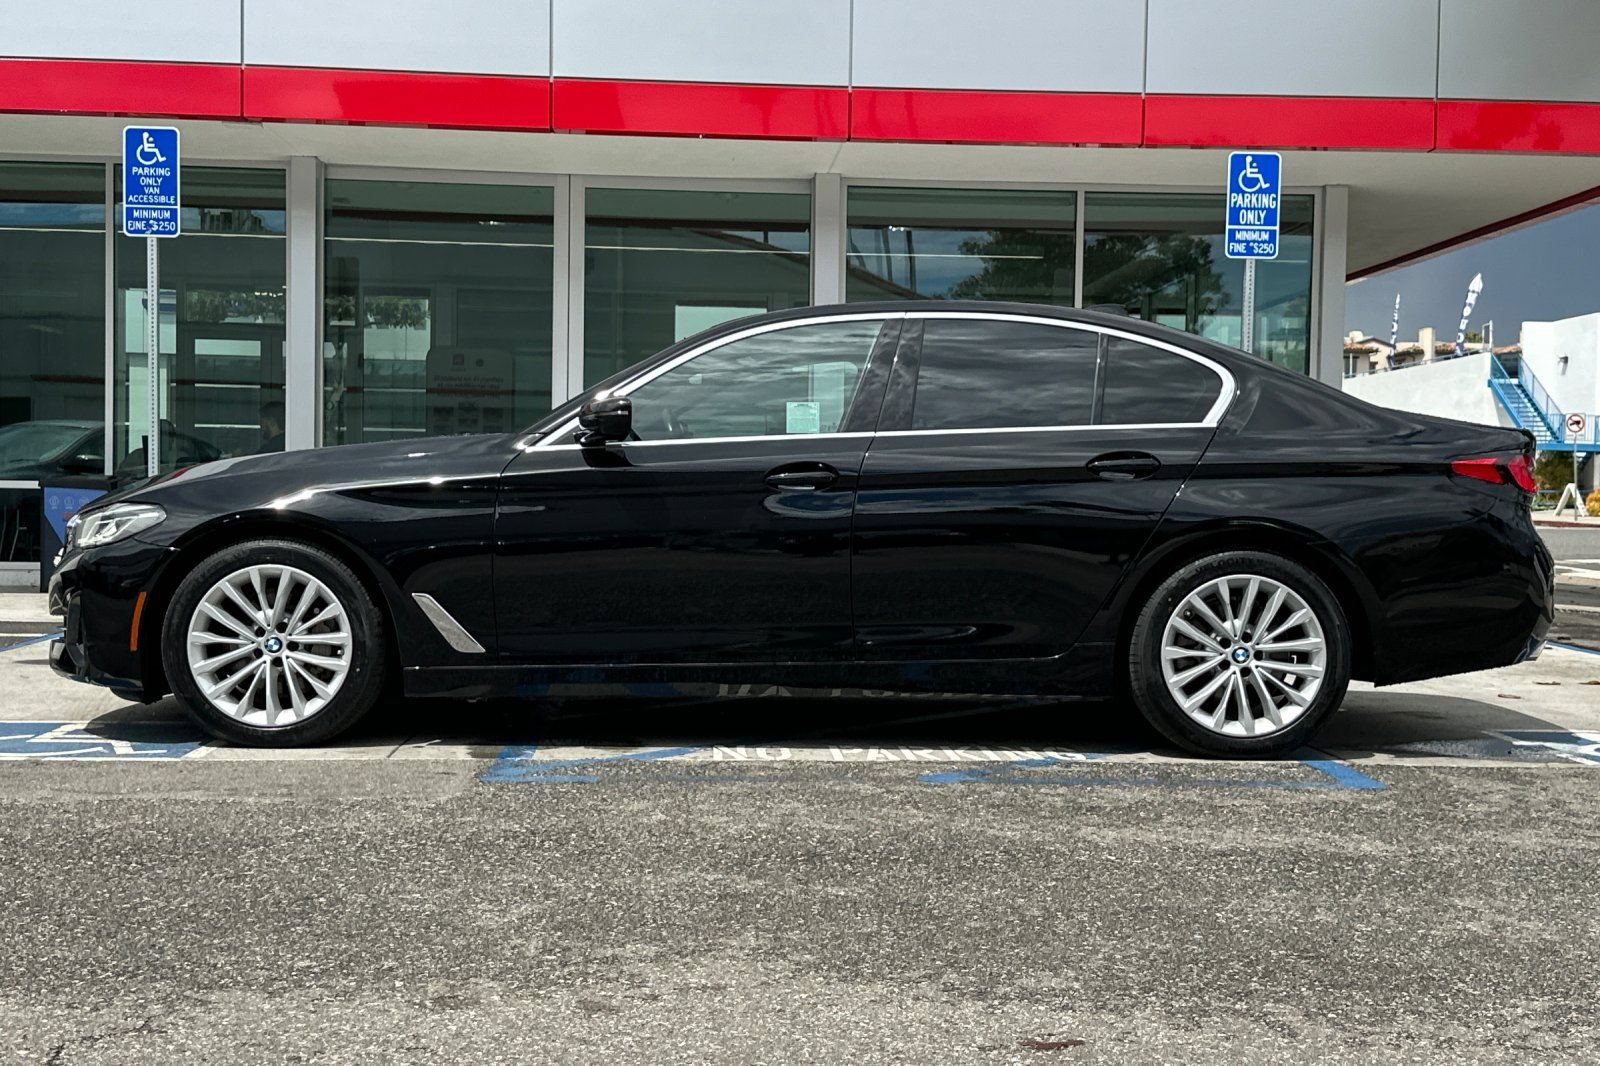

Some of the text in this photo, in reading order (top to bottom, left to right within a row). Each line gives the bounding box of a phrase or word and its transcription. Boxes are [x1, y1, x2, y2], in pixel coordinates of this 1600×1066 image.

[132, 167, 171, 176] PARKING
[140, 177, 163, 186] ONLY
[128, 195, 176, 204] ACCESSIBLE
[1231, 193, 1277, 208] PARKING
[133, 209, 171, 219] MINIMUM
[1239, 210, 1267, 224] ONLY
[127, 220, 147, 231] FINE
[1235, 230, 1269, 241] MINIMUM
[1229, 242, 1275, 254] FINE $250
[712, 745, 1086, 762] NO PARKING
